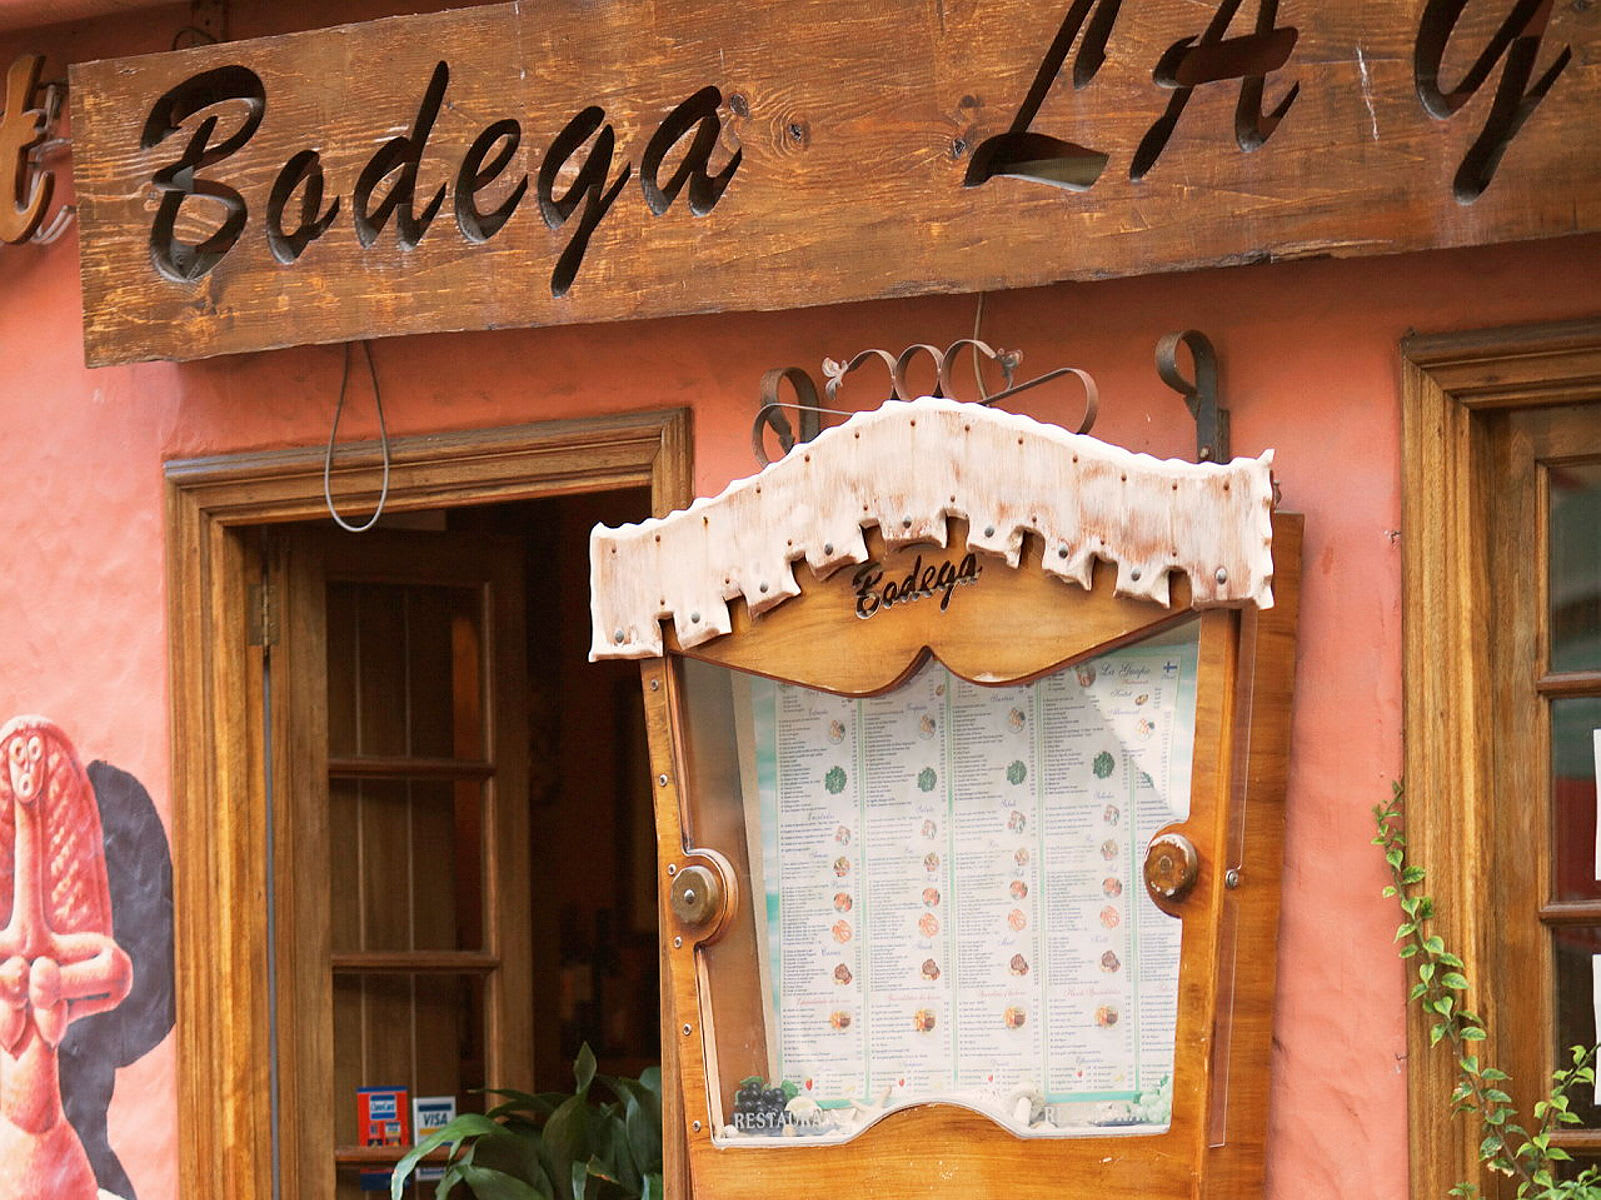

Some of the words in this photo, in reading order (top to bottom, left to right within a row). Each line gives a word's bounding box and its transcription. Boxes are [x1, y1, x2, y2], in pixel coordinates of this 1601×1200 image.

[141, 60, 743, 297] Bodega
[852, 552, 983, 619] Bodega
[423, 1112, 448, 1126] VISA
